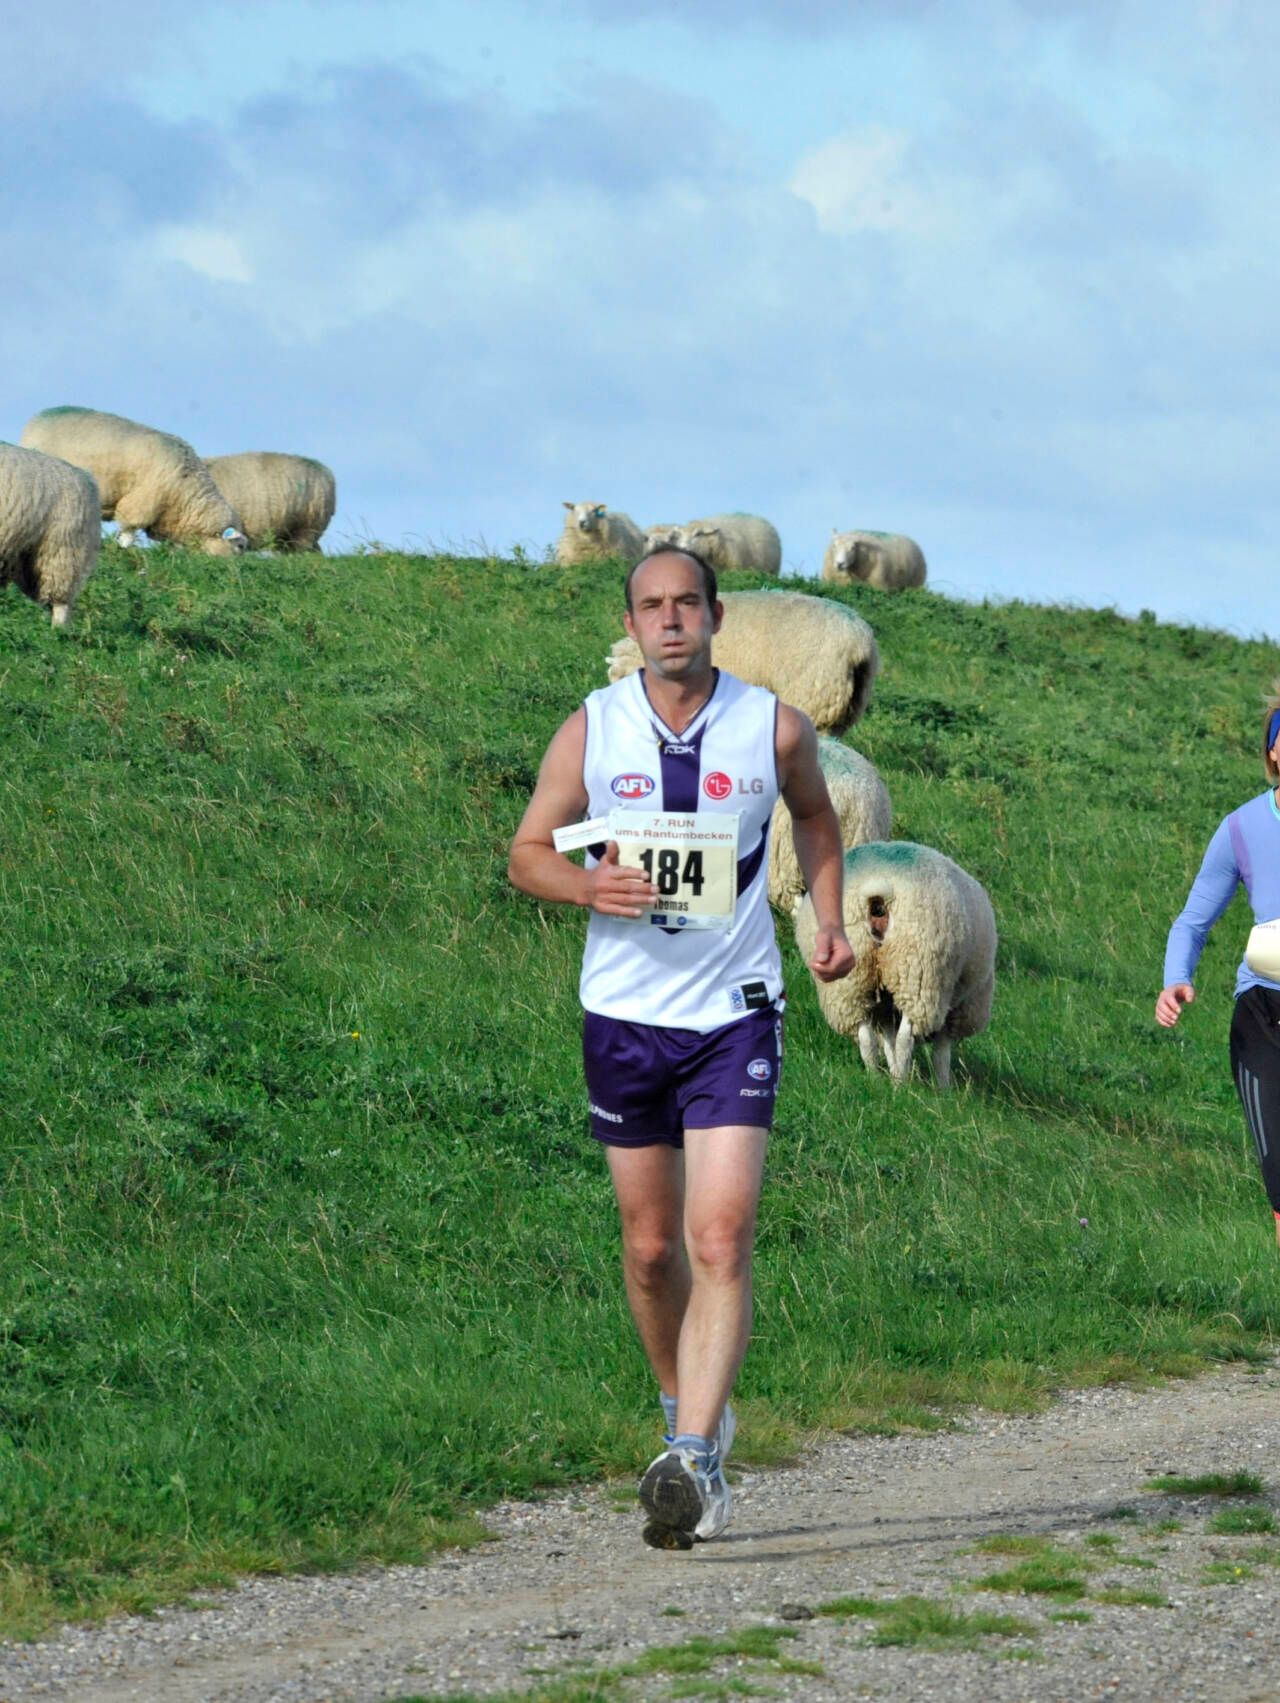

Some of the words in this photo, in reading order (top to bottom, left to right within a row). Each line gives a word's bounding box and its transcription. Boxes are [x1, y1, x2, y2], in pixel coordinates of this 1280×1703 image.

[614, 778, 653, 794] AFL
[738, 778, 764, 795] LG
[668, 818, 696, 828] RUN
[643, 829, 733, 840] Rantumbecken
[639, 848, 705, 897] 184
